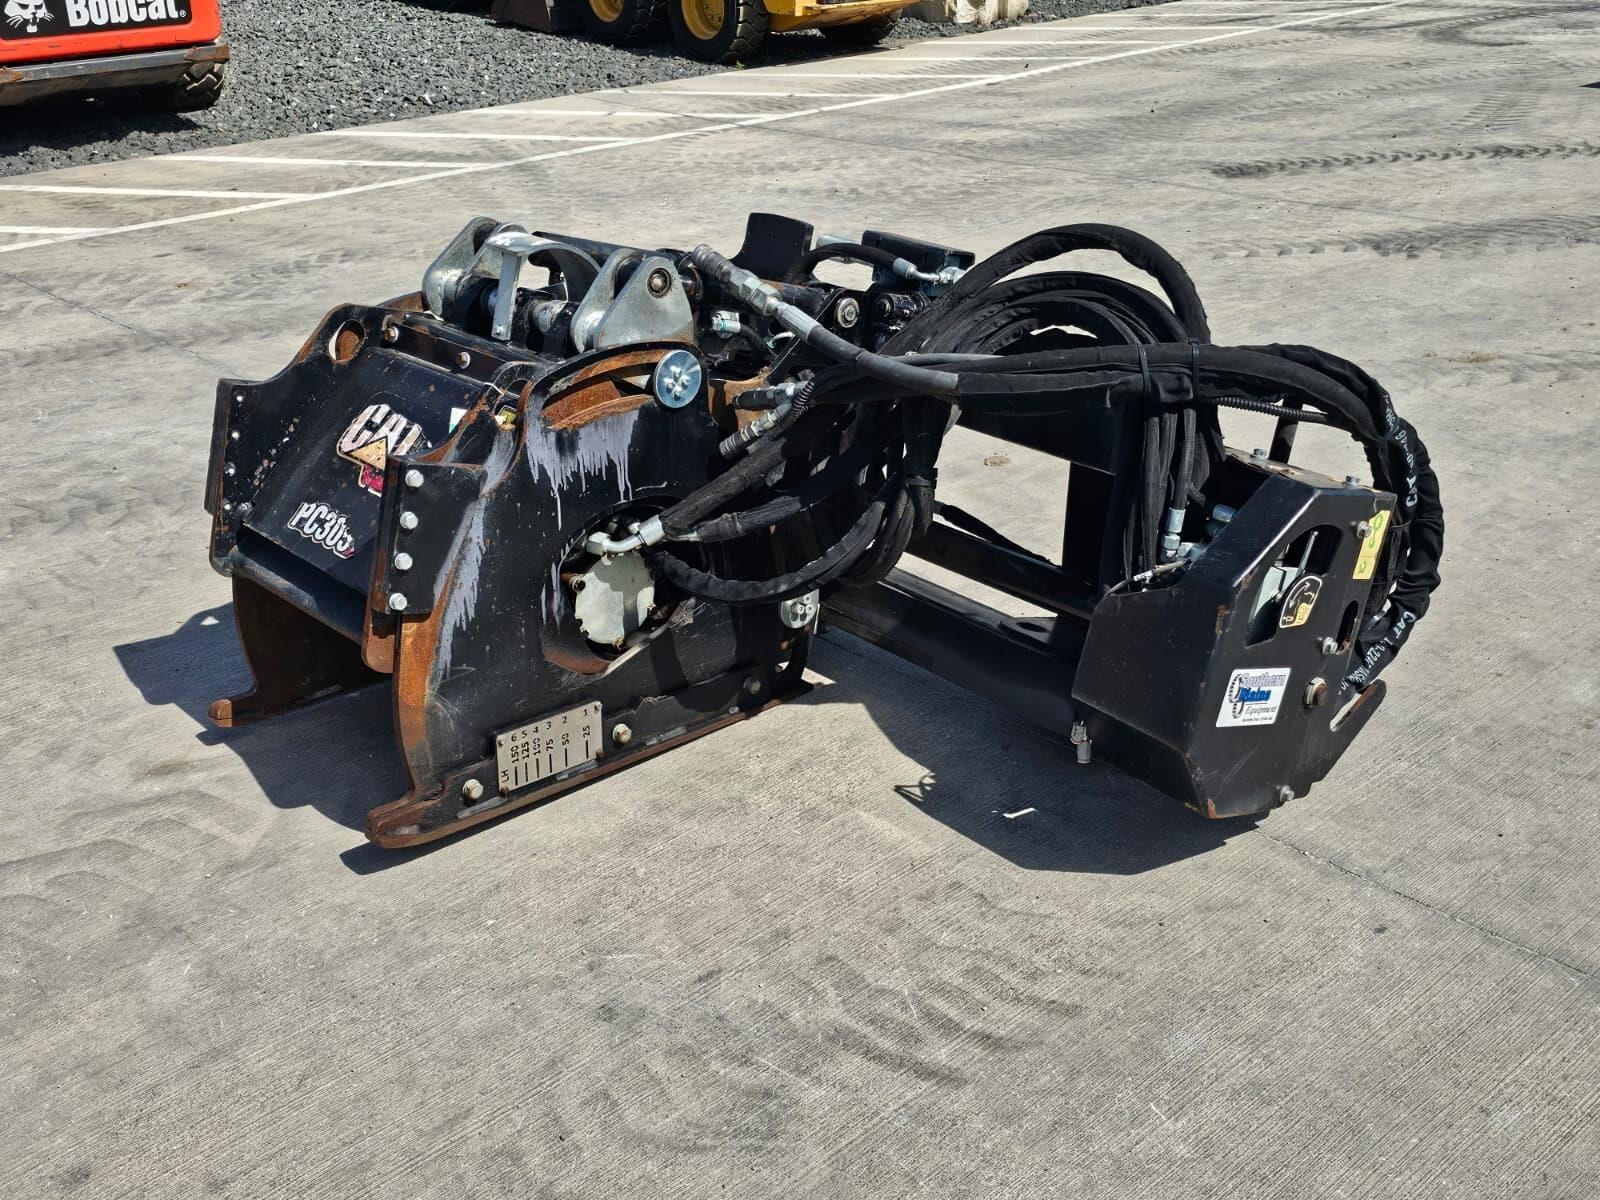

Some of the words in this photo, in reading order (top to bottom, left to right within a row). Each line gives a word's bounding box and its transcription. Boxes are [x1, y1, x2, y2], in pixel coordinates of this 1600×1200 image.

[1392, 611, 1416, 639] CAT
[511, 733, 517, 742] 6
[521, 730, 528, 739] 5
[546, 721, 552, 730] 3
[562, 716, 568, 724] 2
[583, 725, 591, 738] 25
[533, 737, 541, 756] 100
[546, 738, 554, 751] 75
[562, 733, 570, 746] 50
[510, 745, 519, 764] 150
[521, 741, 530, 760] 125
[501, 769, 510, 783] LH
